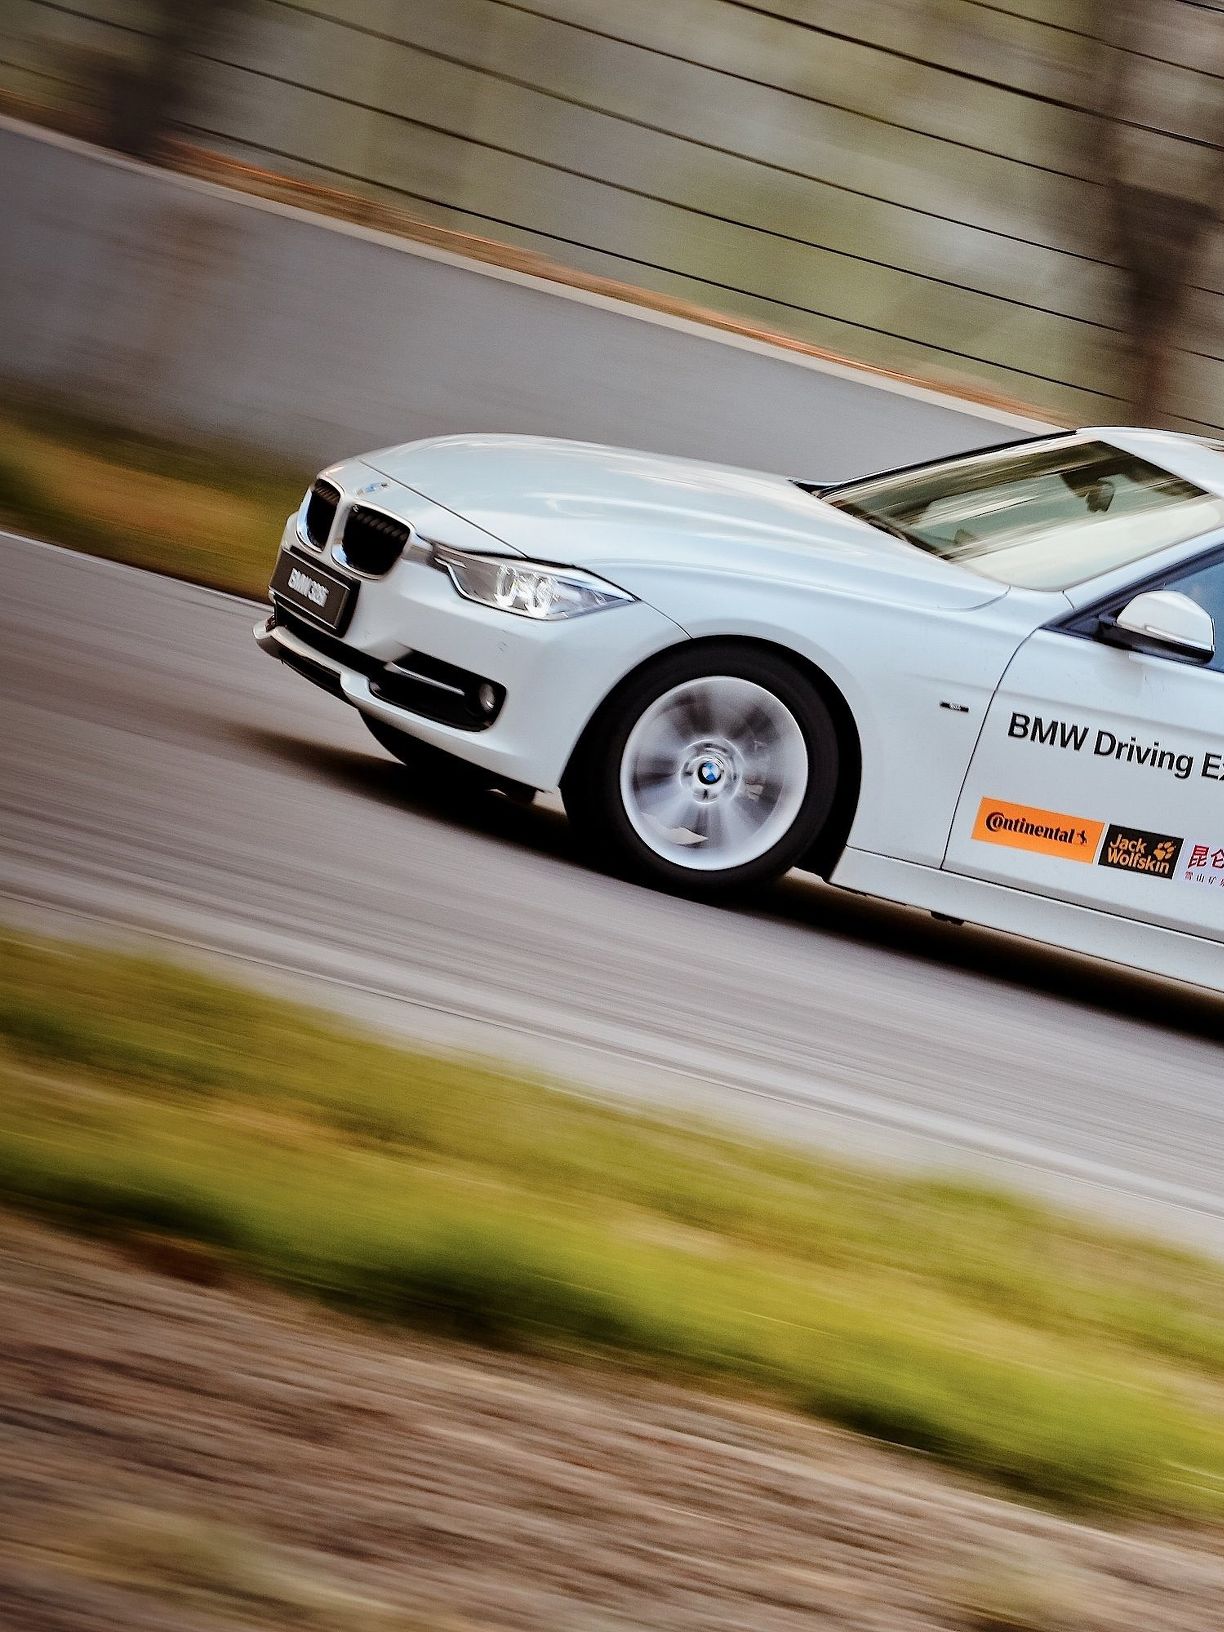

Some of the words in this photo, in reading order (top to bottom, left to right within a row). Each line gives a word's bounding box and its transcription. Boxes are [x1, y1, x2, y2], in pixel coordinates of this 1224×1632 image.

[1008, 712, 1089, 751] BMW
[1094, 730, 1194, 779] Driving
[985, 811, 1075, 844] Continental
[1110, 833, 1147, 854] Jack
[1107, 847, 1170, 875] Wolfskin
